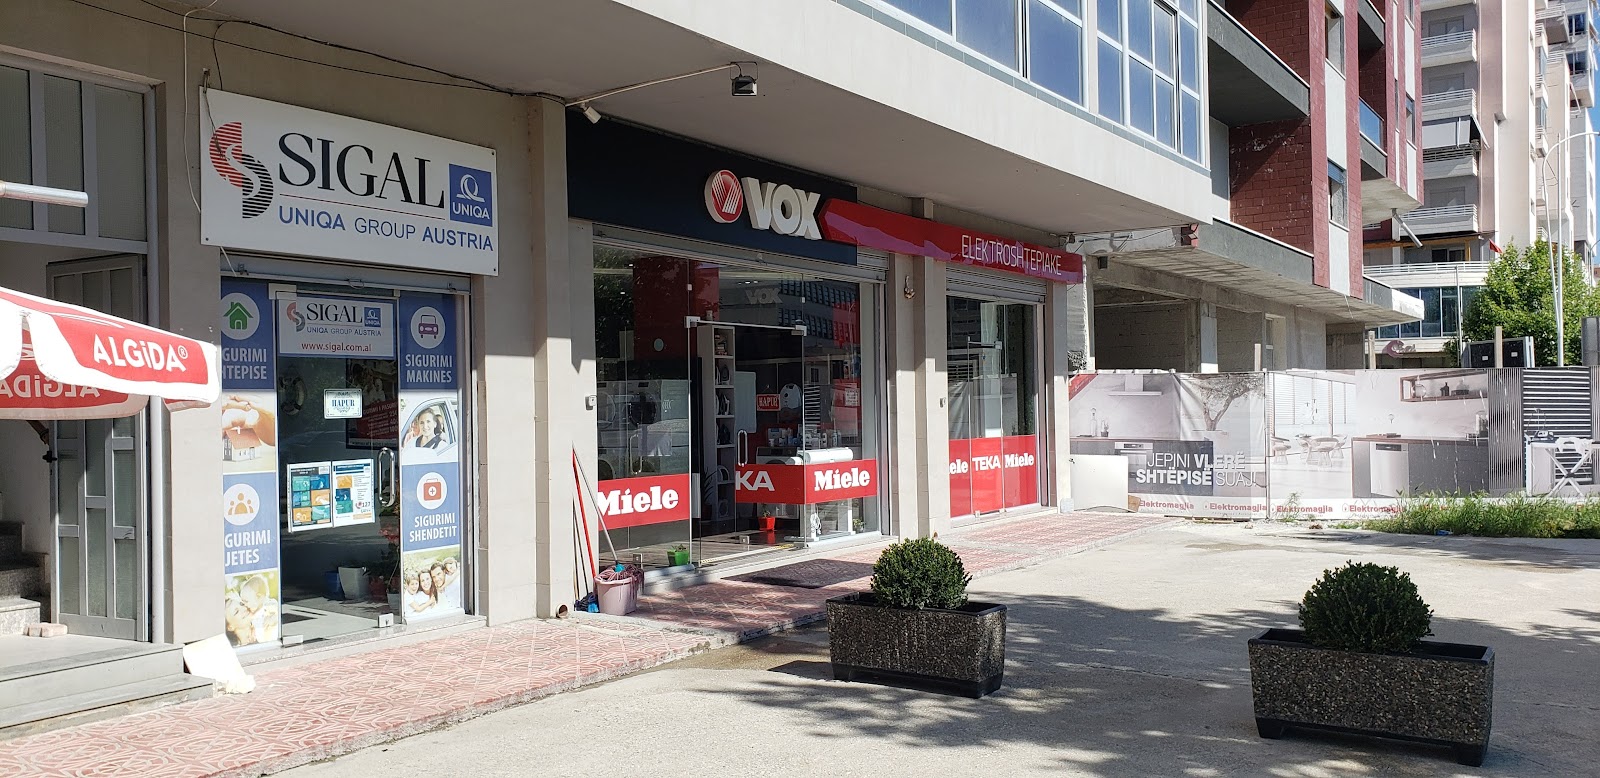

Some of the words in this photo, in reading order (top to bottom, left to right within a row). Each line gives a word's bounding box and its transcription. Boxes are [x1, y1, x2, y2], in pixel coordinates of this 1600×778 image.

[278, 132, 445, 209] SIGAL
[452, 202, 490, 219] UNIQA
[741, 177, 822, 240] VOX
[279, 205, 346, 231] UNIQA
[354, 217, 416, 240] GROUP
[422, 226, 494, 251] AUSTRIA
[961, 234, 1062, 275] ELEKTROSHTEPIAKE
[306, 302, 363, 324] SIGAL
[306, 326, 329, 334] UNIQA
[330, 327, 353, 335] GROUP
[354, 328, 382, 337] AUSTRIA
[222, 347, 267, 363] GURIMI
[301, 342, 372, 353] www.sigal.com.al
[405, 353, 453, 368] SIGURIMI
[406, 369, 453, 383] MAKINES
[971, 455, 1001, 471] TEKA
[1004, 452, 1034, 468] Miele
[1147, 453, 1190, 468] JEPINI
[1193, 450, 1246, 469] VLERË
[735, 470, 775, 491] KA
[814, 467, 871, 491] Miele
[1136, 466, 1213, 486] SHTËPISË
[1215, 470, 1257, 488] SUAJ!
[597, 485, 679, 516] Miele
[1209, 502, 1267, 513] Elektromagjia
[414, 512, 456, 528] SIGURIMI
[224, 529, 271, 549] GURIMI
[409, 525, 458, 543] SHENDETIT
[224, 548, 260, 567] JETES
